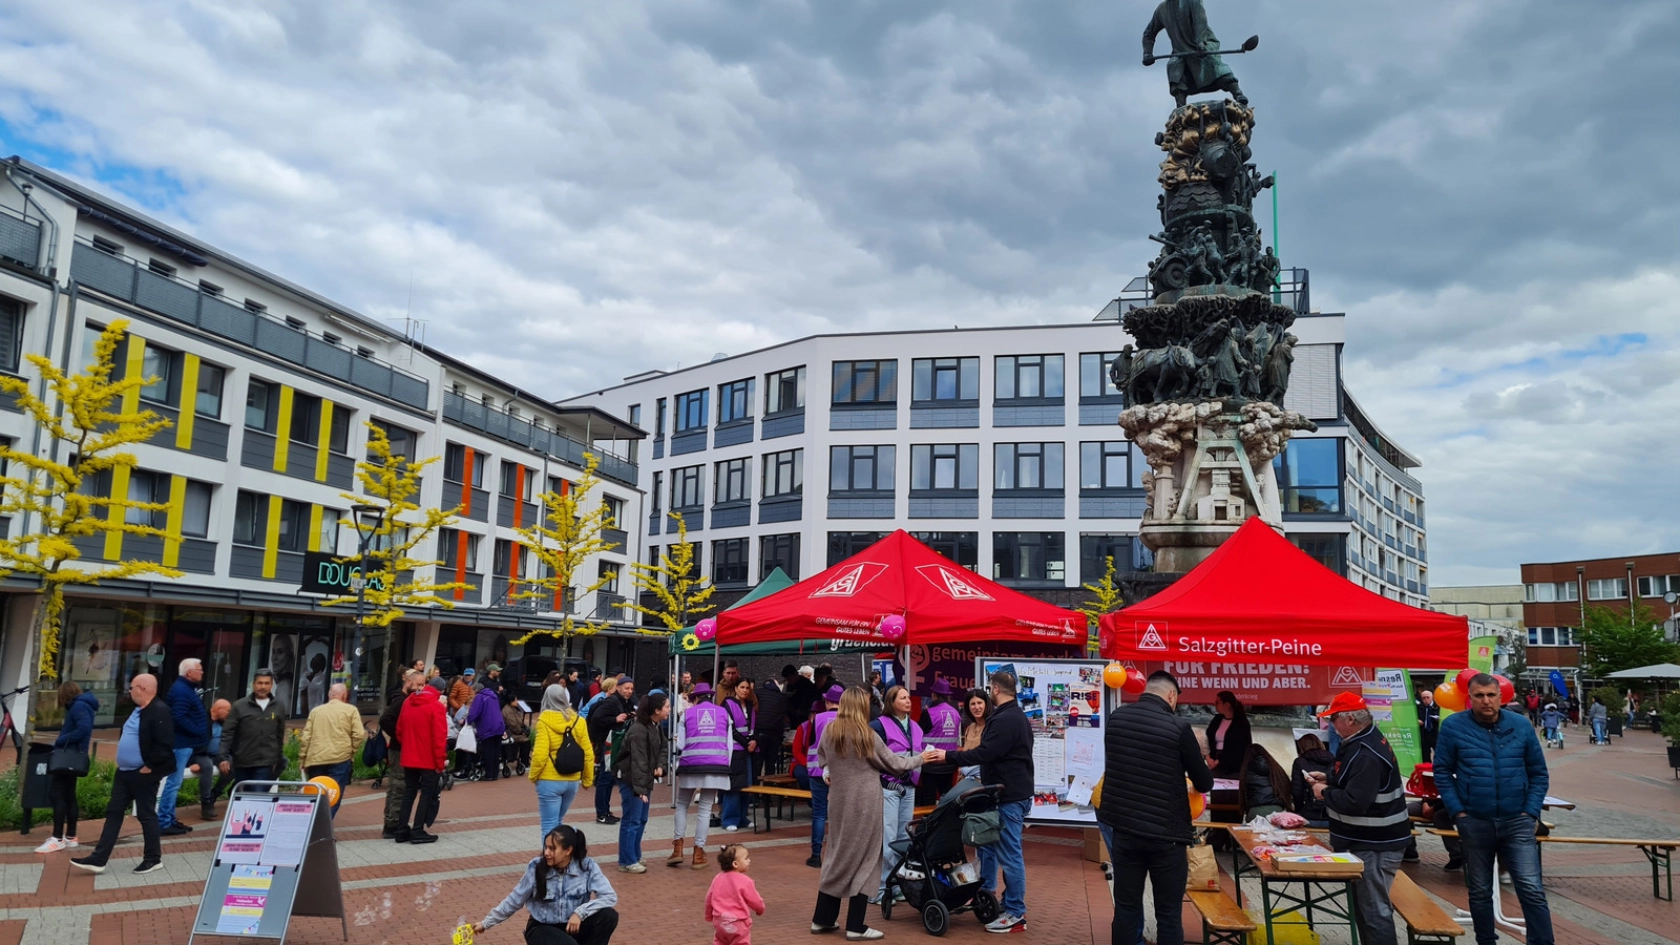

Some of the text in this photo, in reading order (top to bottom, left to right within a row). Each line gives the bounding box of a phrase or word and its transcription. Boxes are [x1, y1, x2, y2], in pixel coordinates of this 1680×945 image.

[1179, 637, 1322, 656] Salzgitter-Peine
[1201, 677, 1239, 689] WENN
[1242, 677, 1269, 689] UND
[1272, 677, 1311, 689] ABER.
